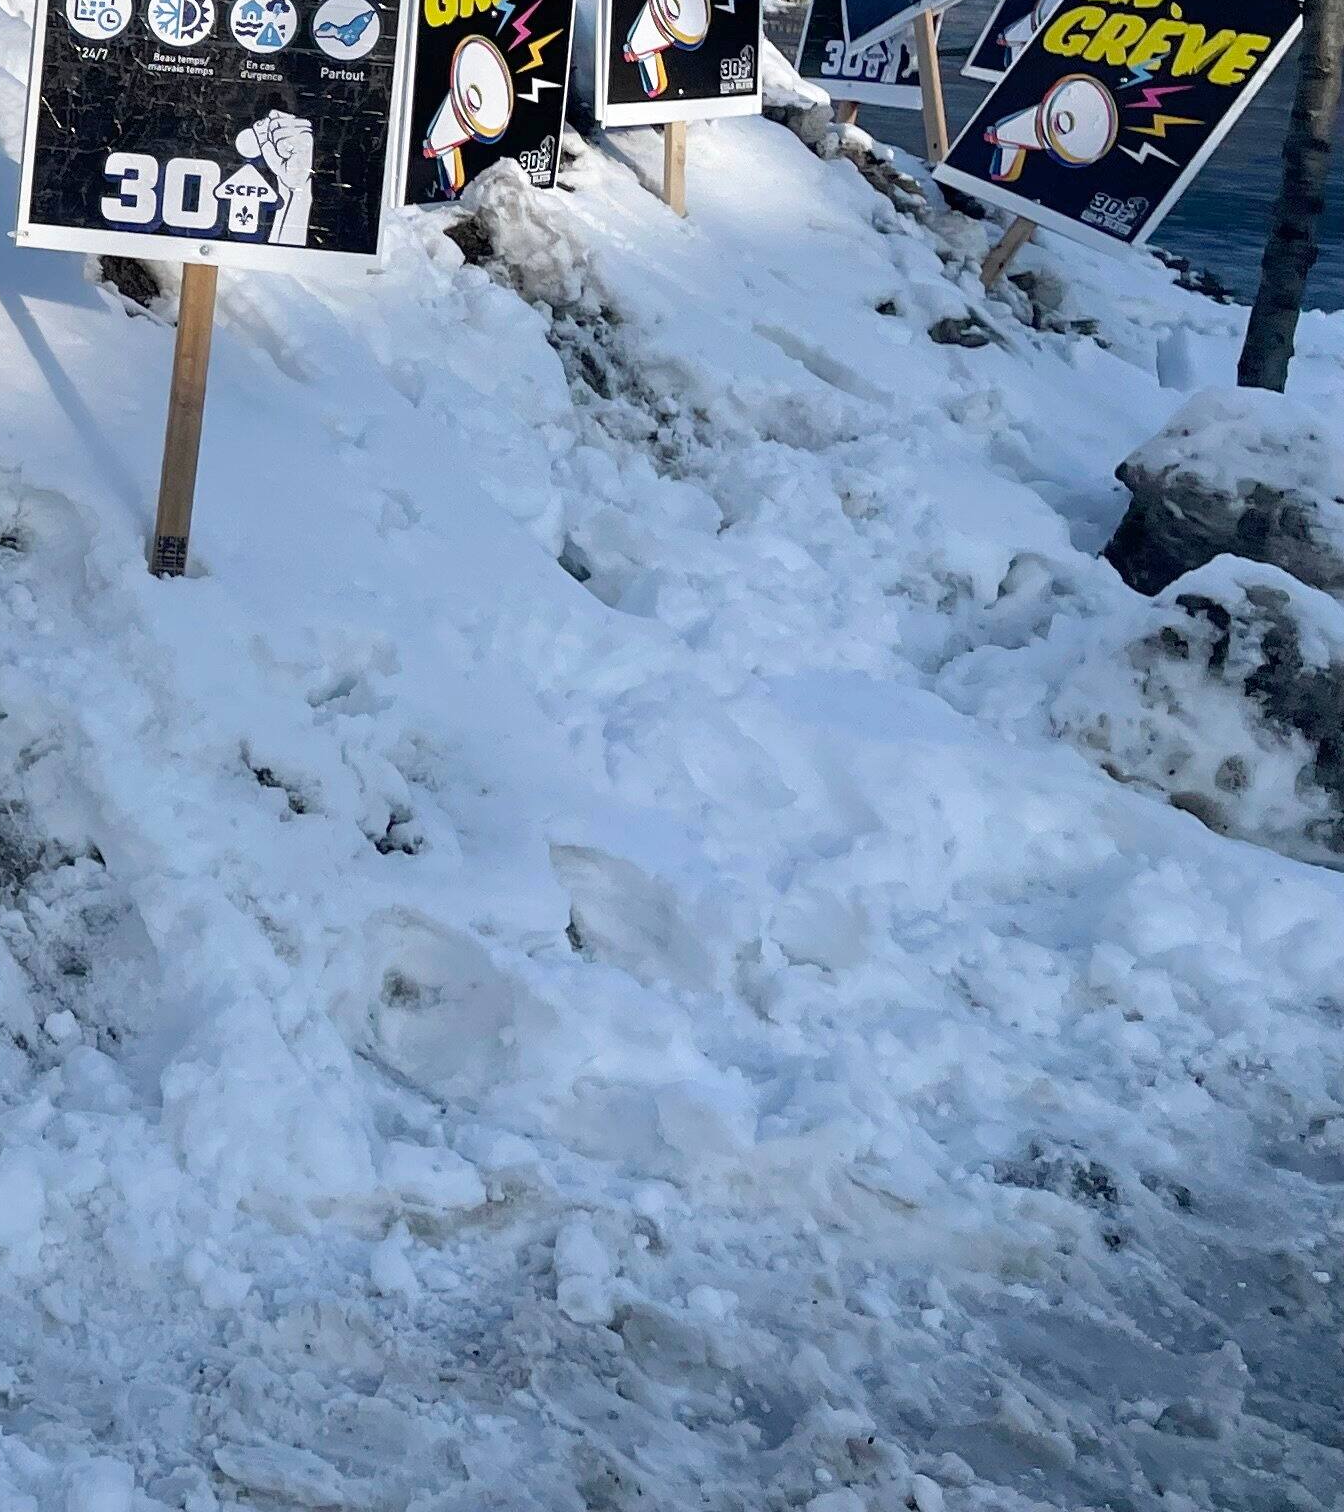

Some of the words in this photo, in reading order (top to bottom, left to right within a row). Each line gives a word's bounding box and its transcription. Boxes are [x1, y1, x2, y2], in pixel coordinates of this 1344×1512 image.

[1043, 2, 1271, 85] GRÈVE
[81, 47, 109, 61] 24/7
[153, 52, 176, 63] Beau
[147, 63, 185, 74] mauvais
[186, 67, 214, 77] temps
[246, 60, 258, 70] En
[259, 63, 276, 71] cas
[240, 70, 283, 82] d'urgence
[320, 67, 365, 82] Partout
[225, 184, 269, 197] SCFP
